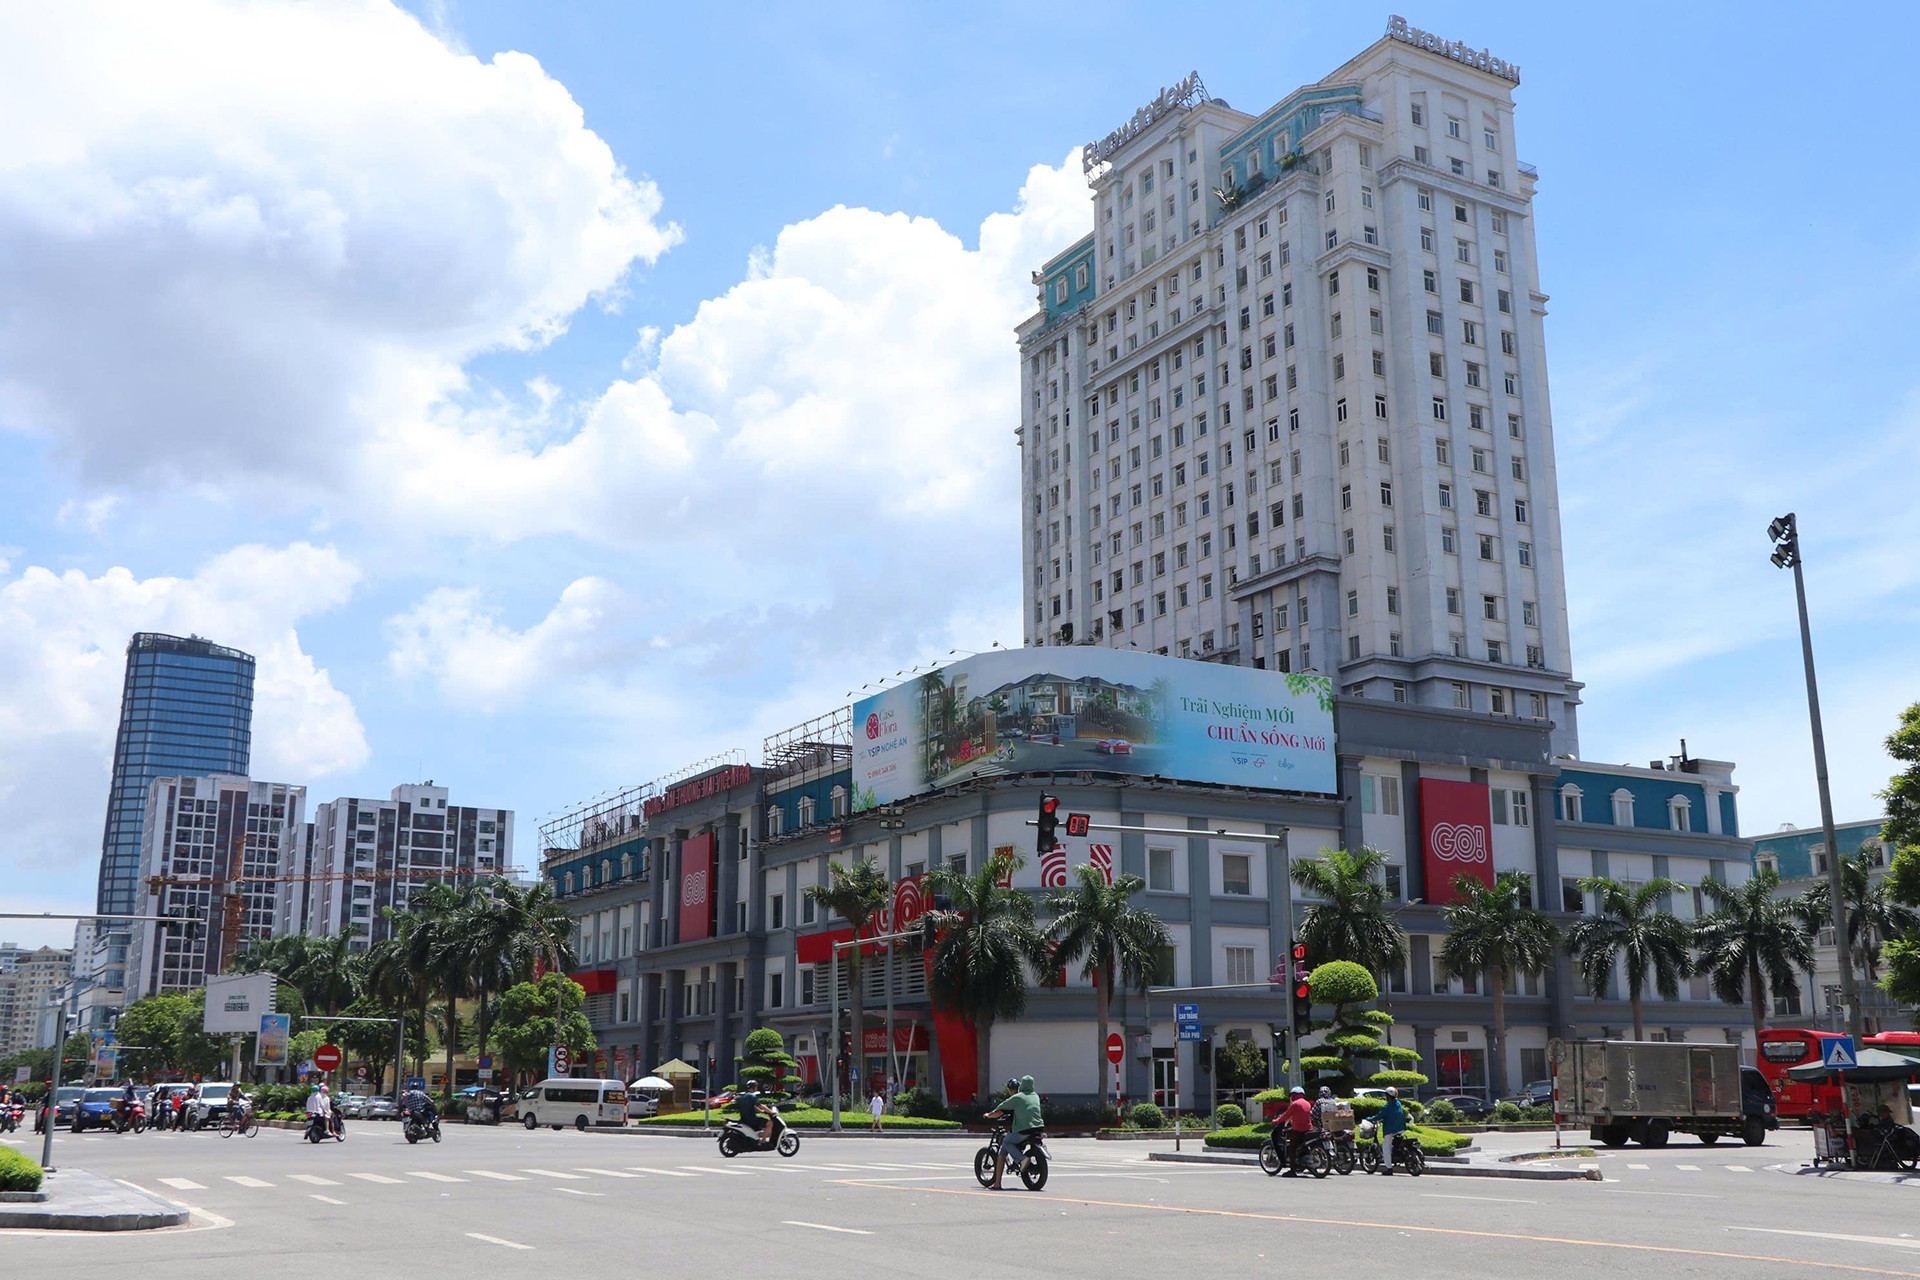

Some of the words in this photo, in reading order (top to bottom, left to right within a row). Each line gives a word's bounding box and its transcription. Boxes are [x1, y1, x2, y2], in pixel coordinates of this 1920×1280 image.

[1390, 14, 1520, 82] Eurowindow
[1083, 70, 1198, 174] Eurowindow
[878, 709, 895, 720] Casa
[1180, 697, 1208, 714] Trải
[1212, 700, 1262, 722] Nghiệm
[1265, 706, 1295, 724] MỚI
[879, 722, 898, 737] Flora
[1207, 722, 1258, 744] CHUẨN
[1261, 725, 1300, 748] SỐNG
[1303, 735, 1326, 751] Mới
[1069, 816, 1088, 834] 07
[1430, 822, 1487, 864] GO!
[683, 870, 707, 907] GO!
